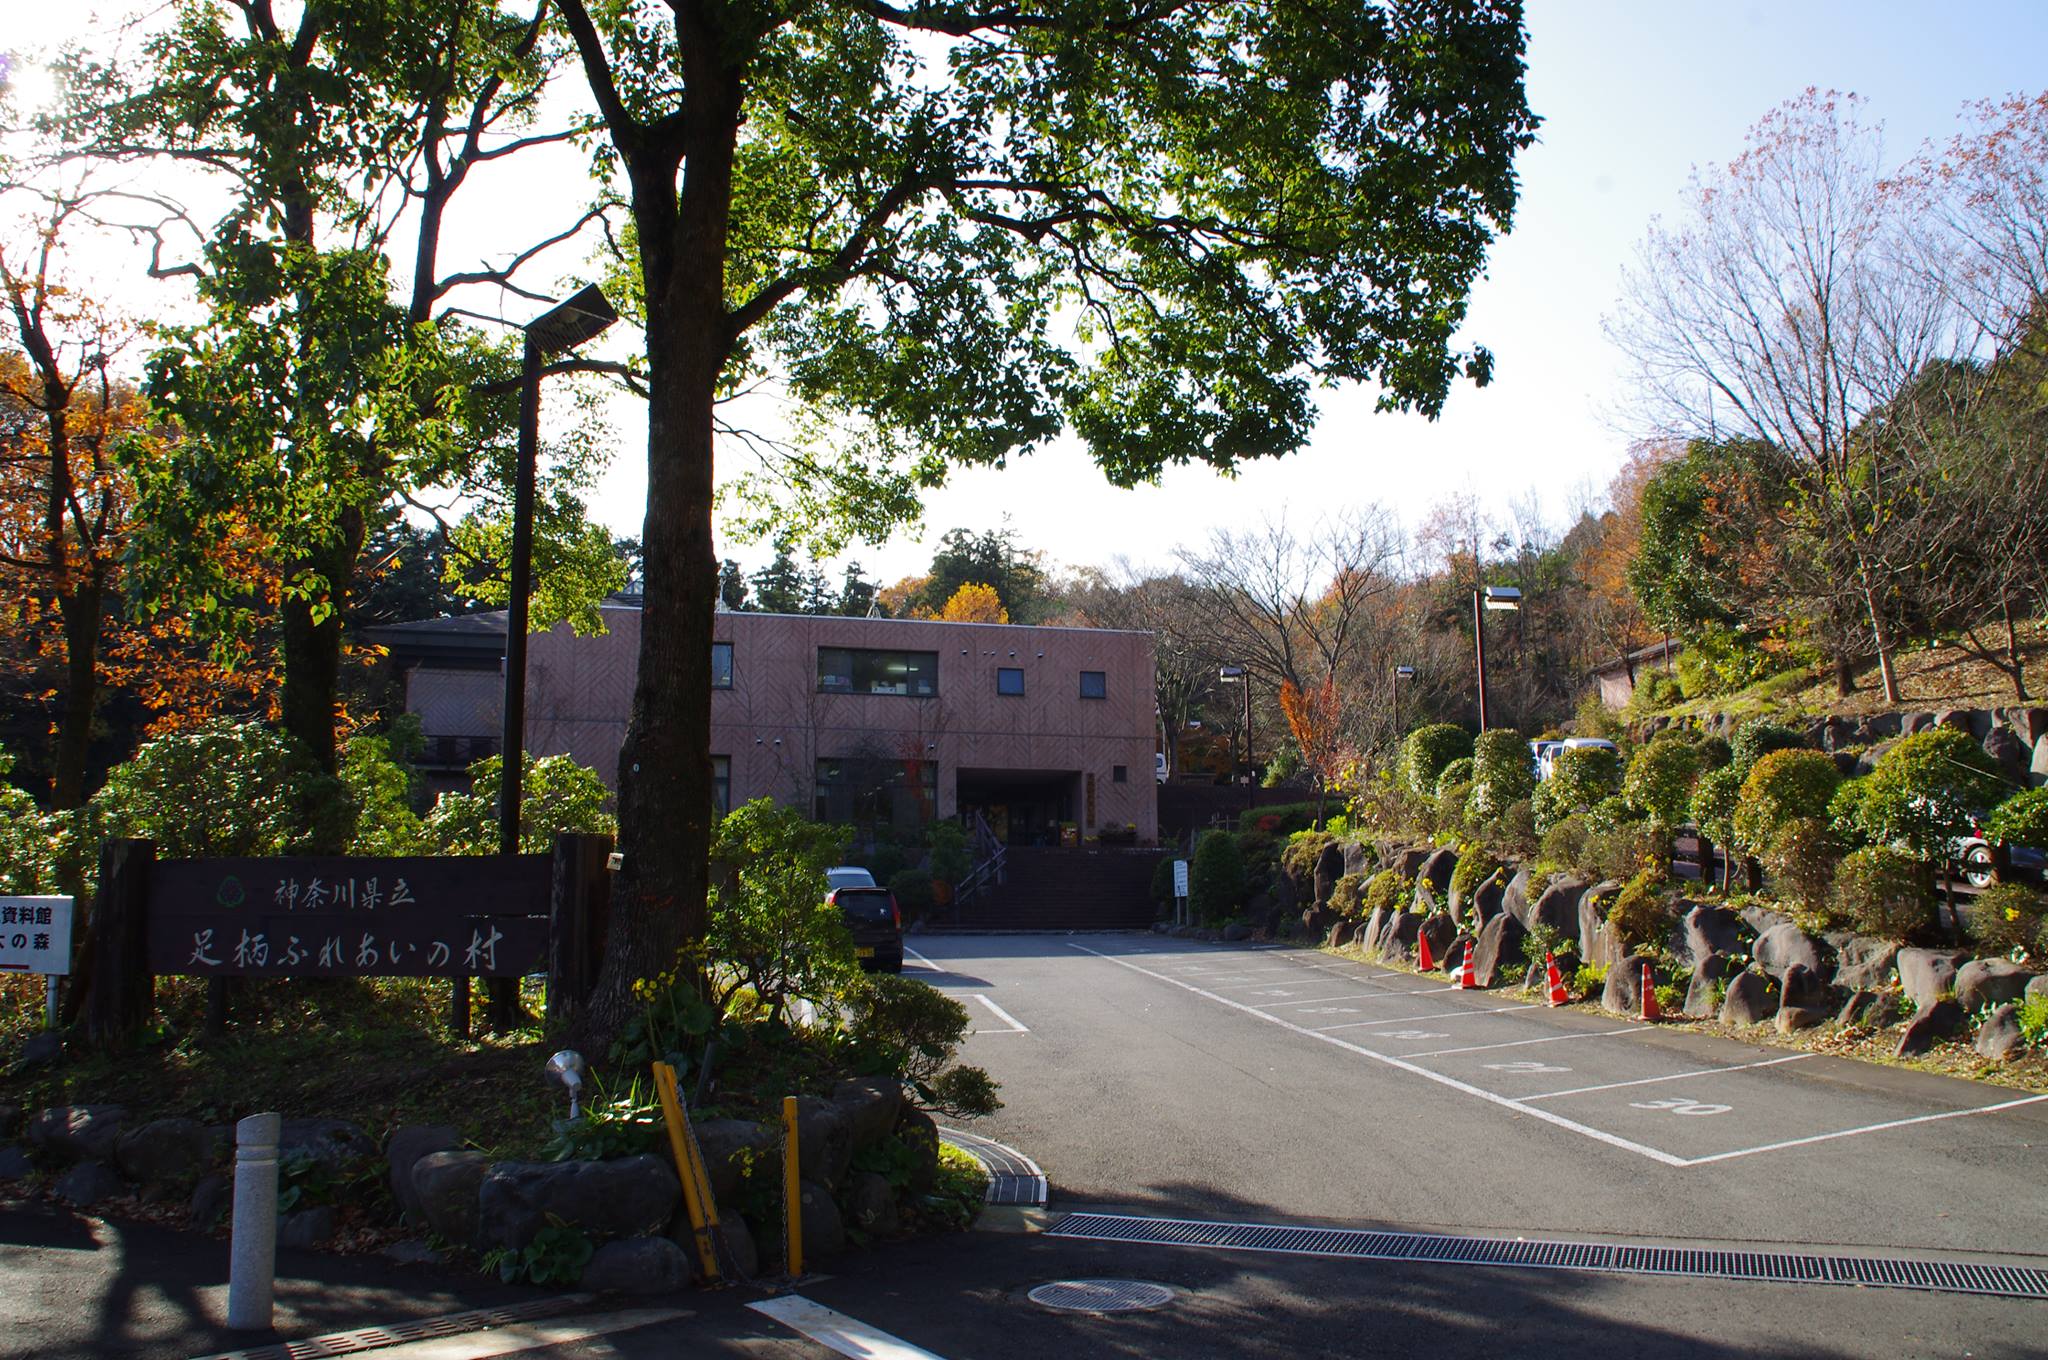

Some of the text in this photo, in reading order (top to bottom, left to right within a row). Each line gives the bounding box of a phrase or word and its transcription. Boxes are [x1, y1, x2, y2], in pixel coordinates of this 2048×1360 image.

[274, 876, 415, 910] 神奈川県立
[0, 905, 52, 925] 資料館
[187, 924, 503, 970] 足柄ふれあいの村
[1628, 1097, 1733, 1115] 30
